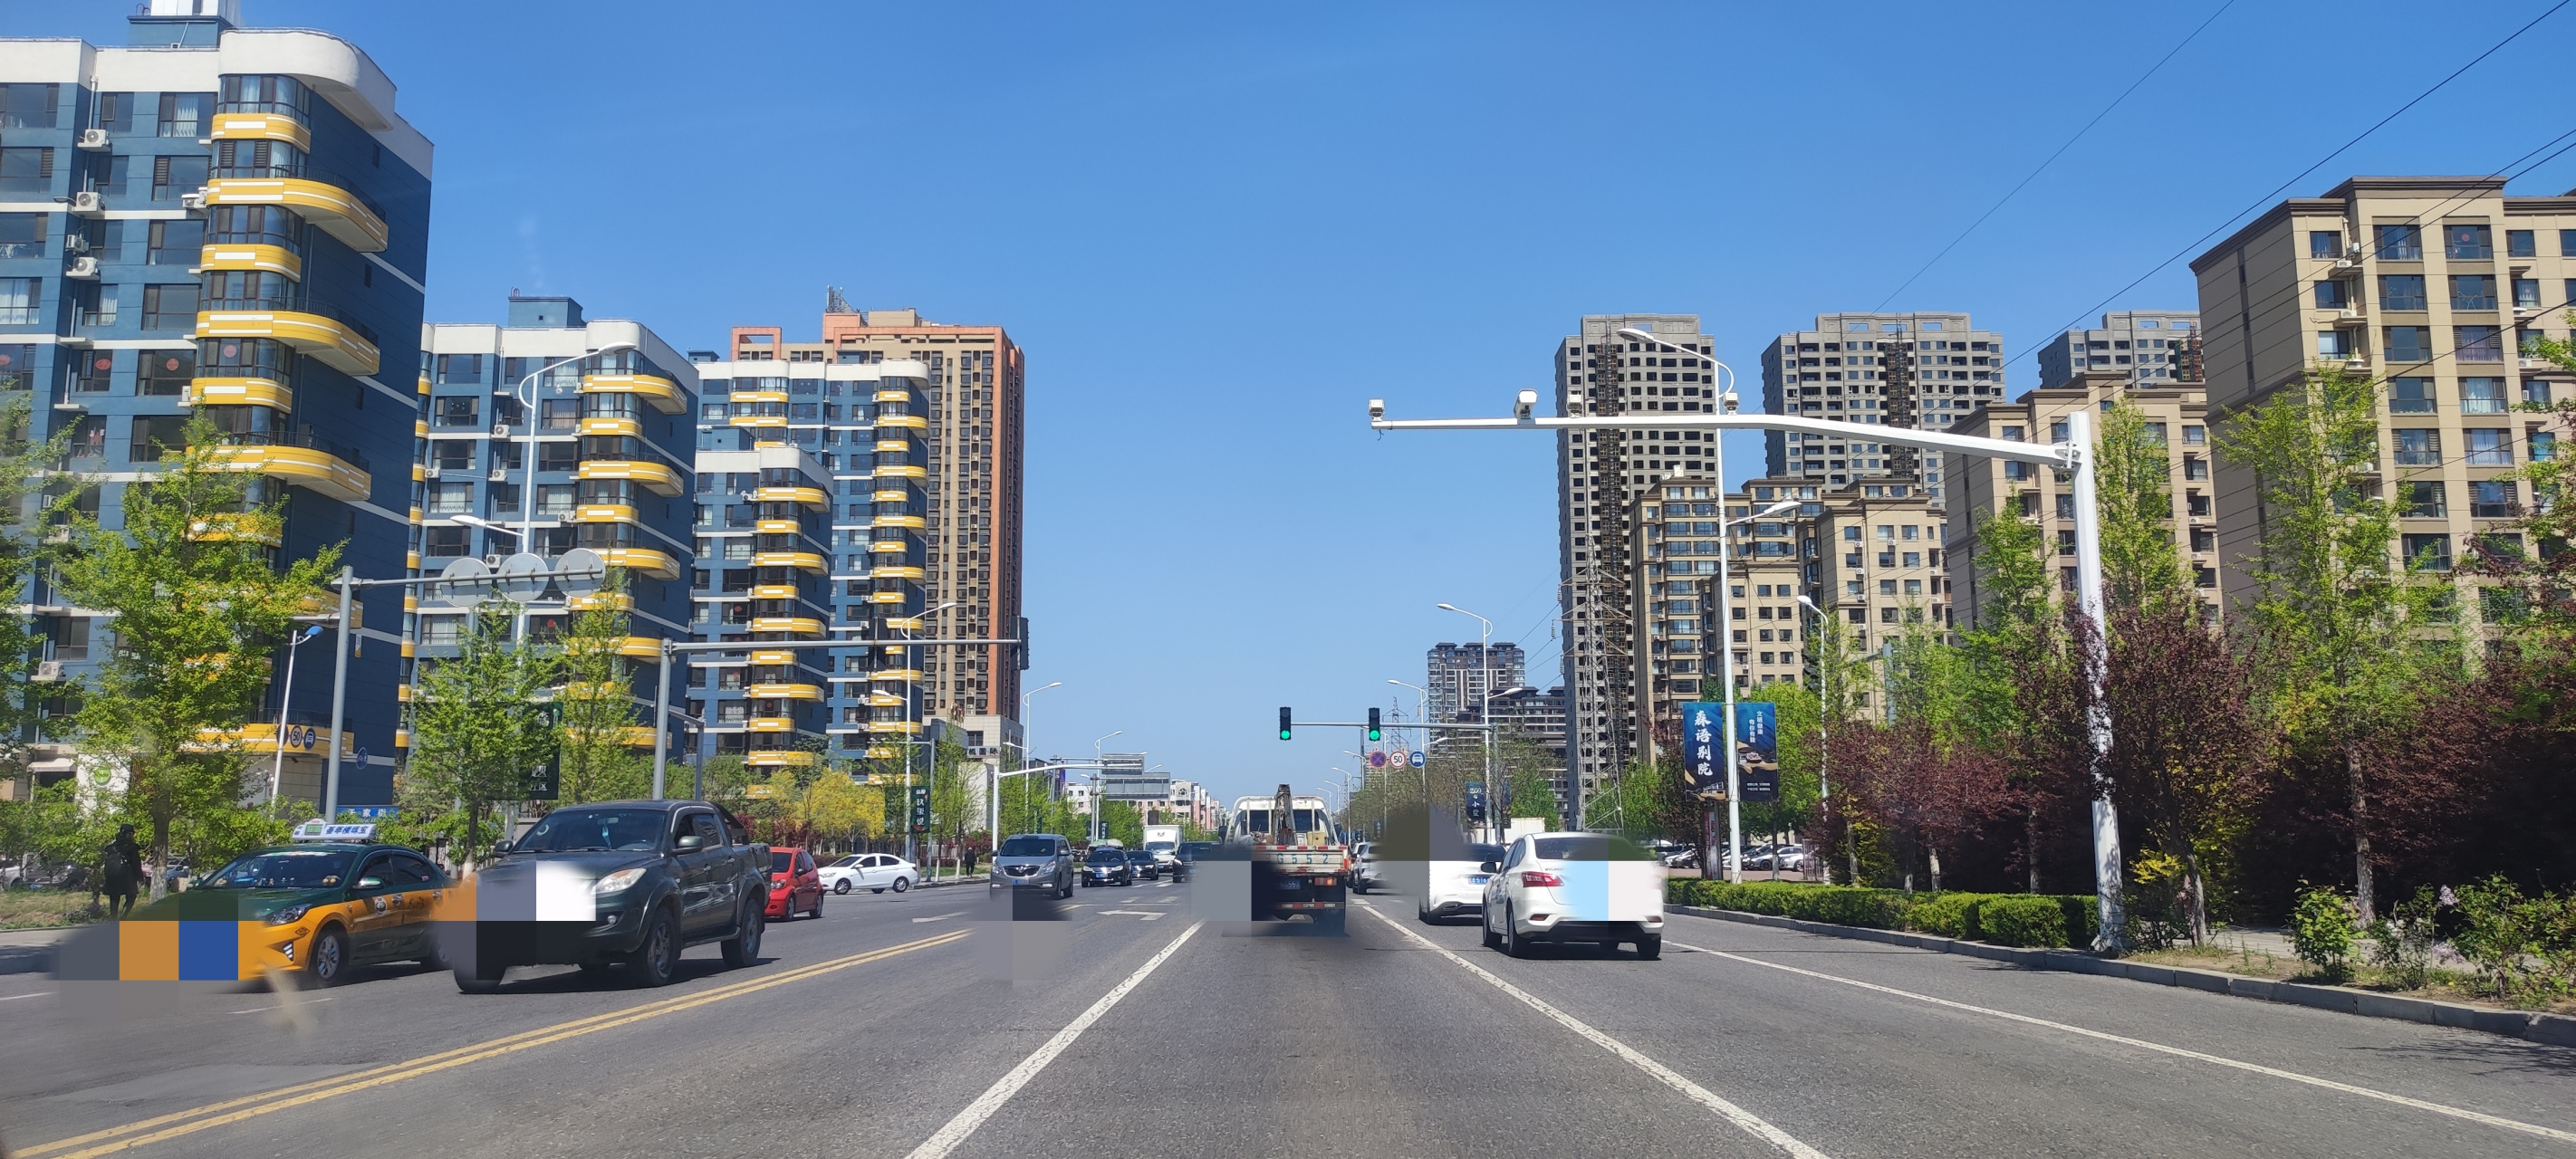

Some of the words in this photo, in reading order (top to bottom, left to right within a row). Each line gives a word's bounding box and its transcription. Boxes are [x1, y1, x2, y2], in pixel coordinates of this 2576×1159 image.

[293, 732, 301, 742] 50
[1694, 709, 1713, 776] 森语别院
[1393, 755, 1403, 763] 50
